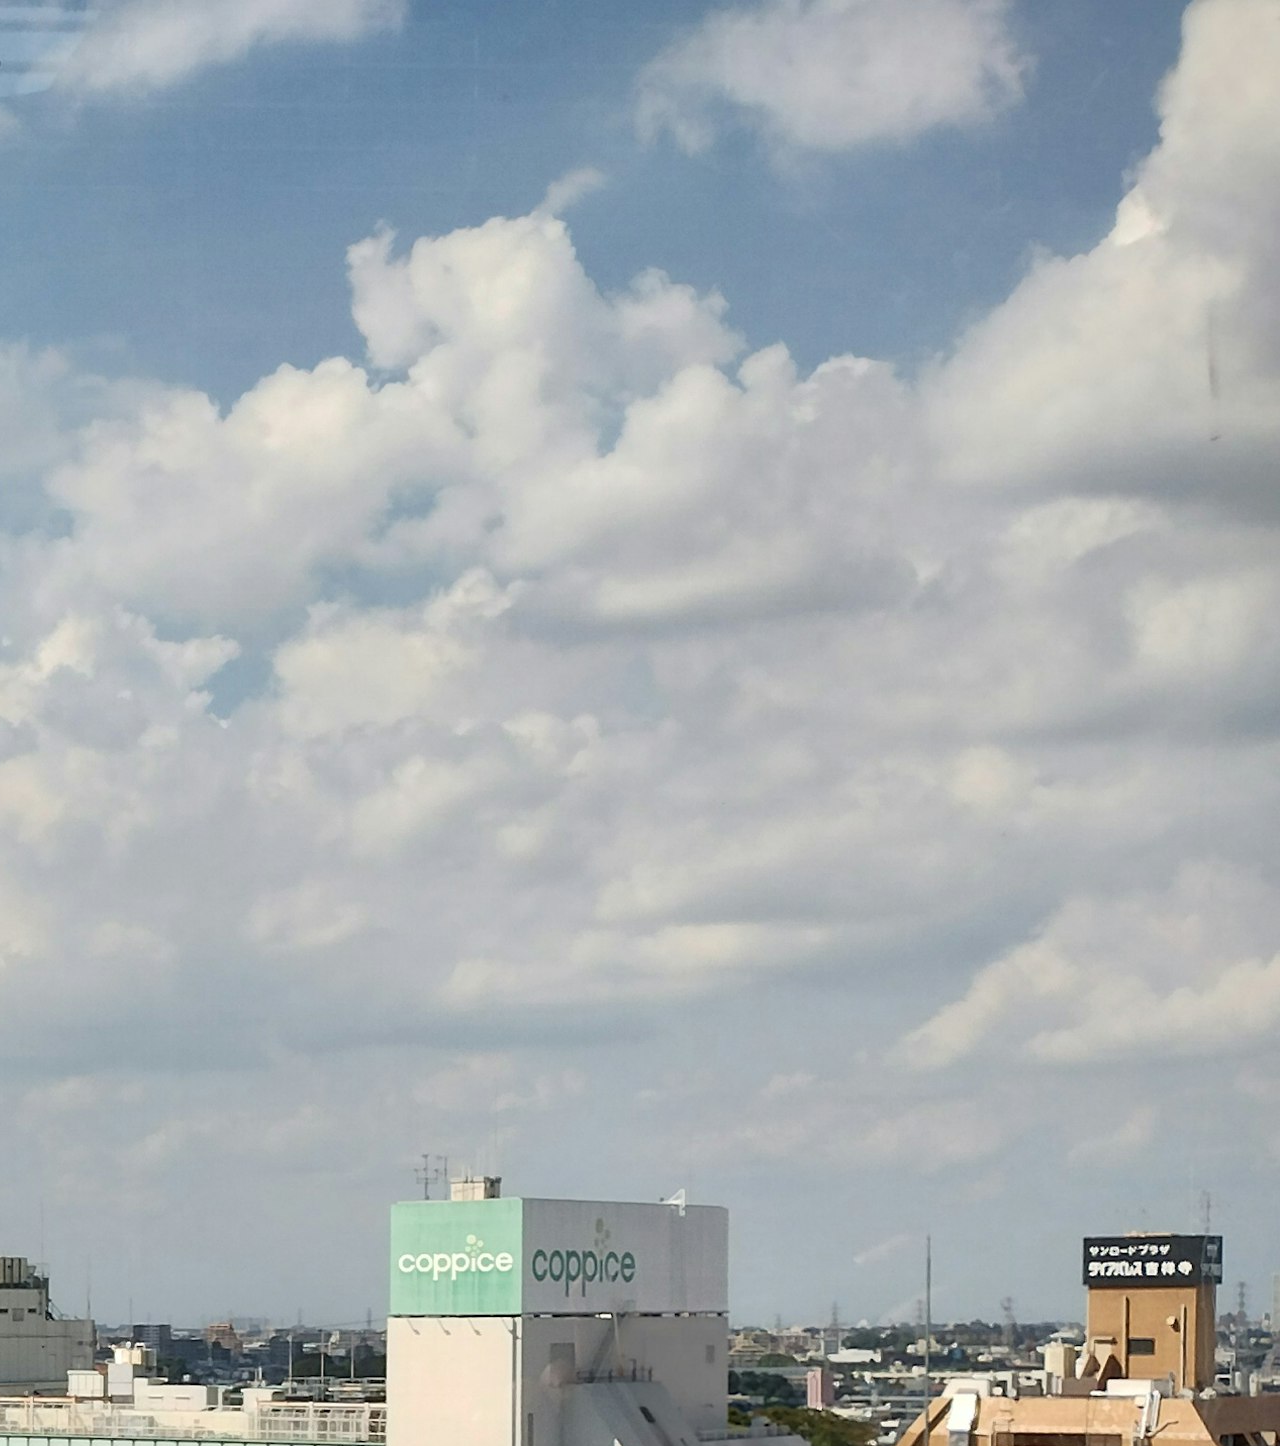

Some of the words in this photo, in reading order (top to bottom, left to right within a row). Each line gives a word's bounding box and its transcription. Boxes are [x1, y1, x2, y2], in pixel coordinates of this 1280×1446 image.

[1089, 1243, 1170, 1257] サンロードプラザ
[398, 1251, 513, 1281] coppice
[532, 1249, 636, 1298] coppice
[1144, 1260, 1194, 1277] 吉祥寺
